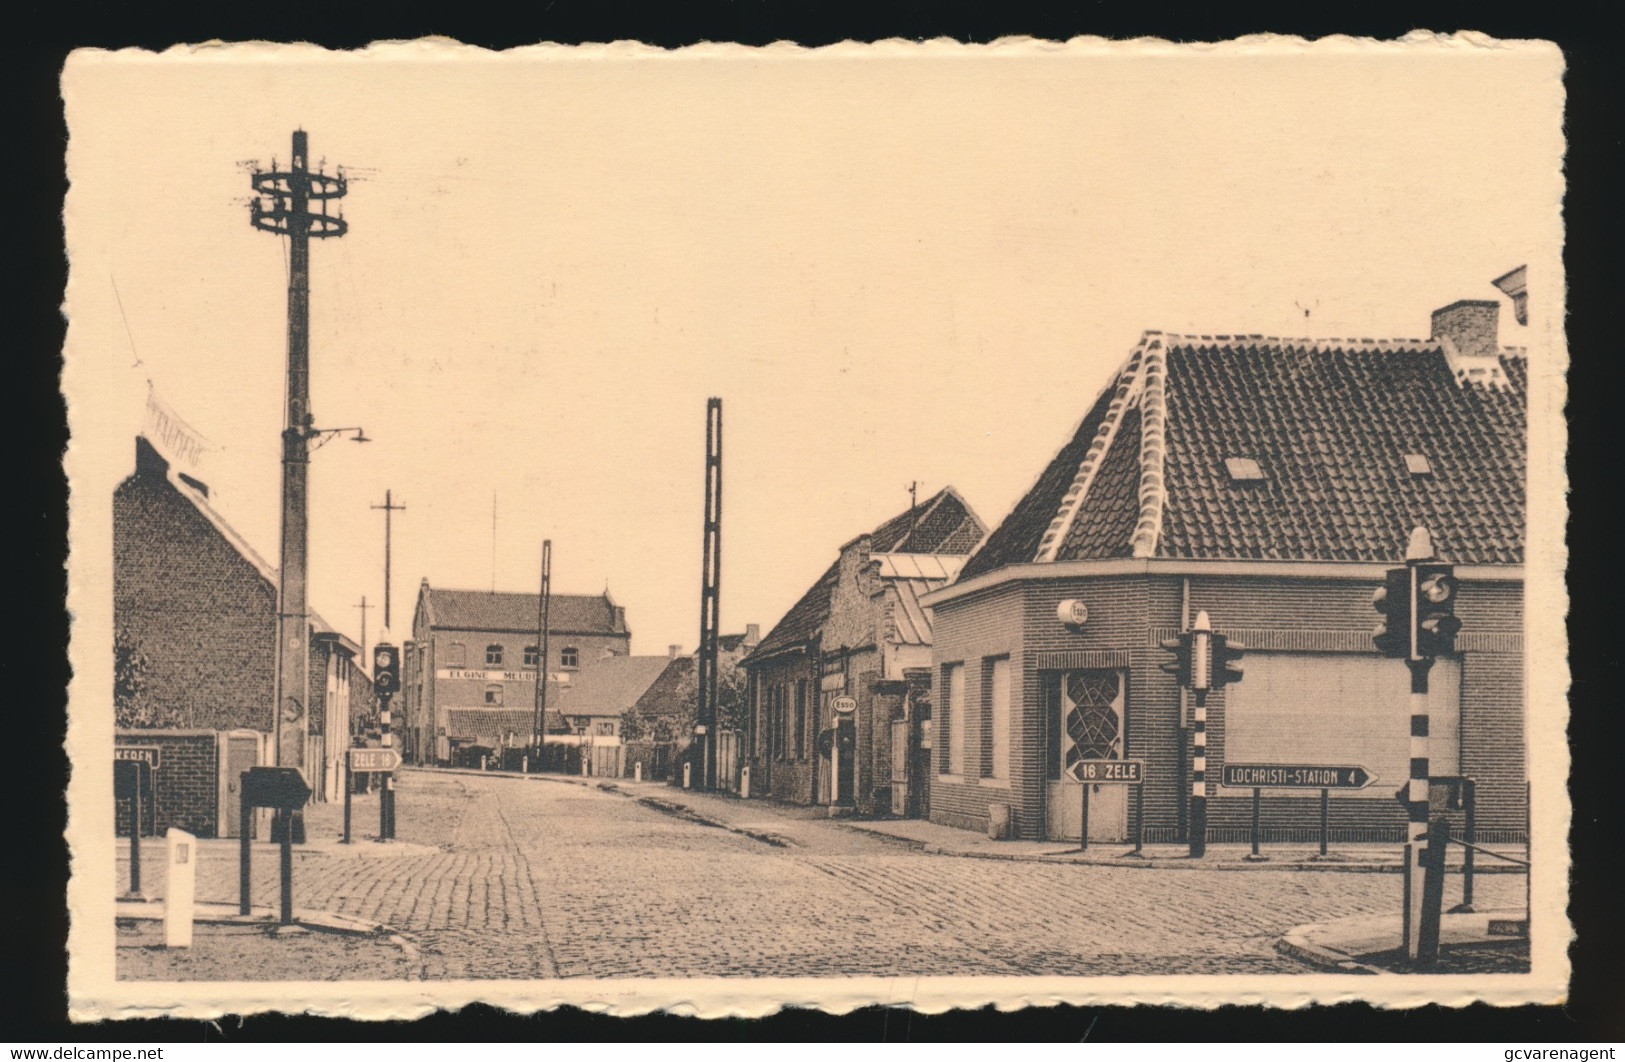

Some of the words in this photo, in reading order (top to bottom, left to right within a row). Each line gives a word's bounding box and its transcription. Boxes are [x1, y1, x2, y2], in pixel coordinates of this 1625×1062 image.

[354, 753, 375, 767] ZELE
[381, 753, 391, 767] 16
[1082, 764, 1096, 779] 16
[1105, 764, 1136, 779] ZELE
[1230, 768, 1338, 784] LOCHRISTI-STATION
[1348, 770, 1356, 784] 4
